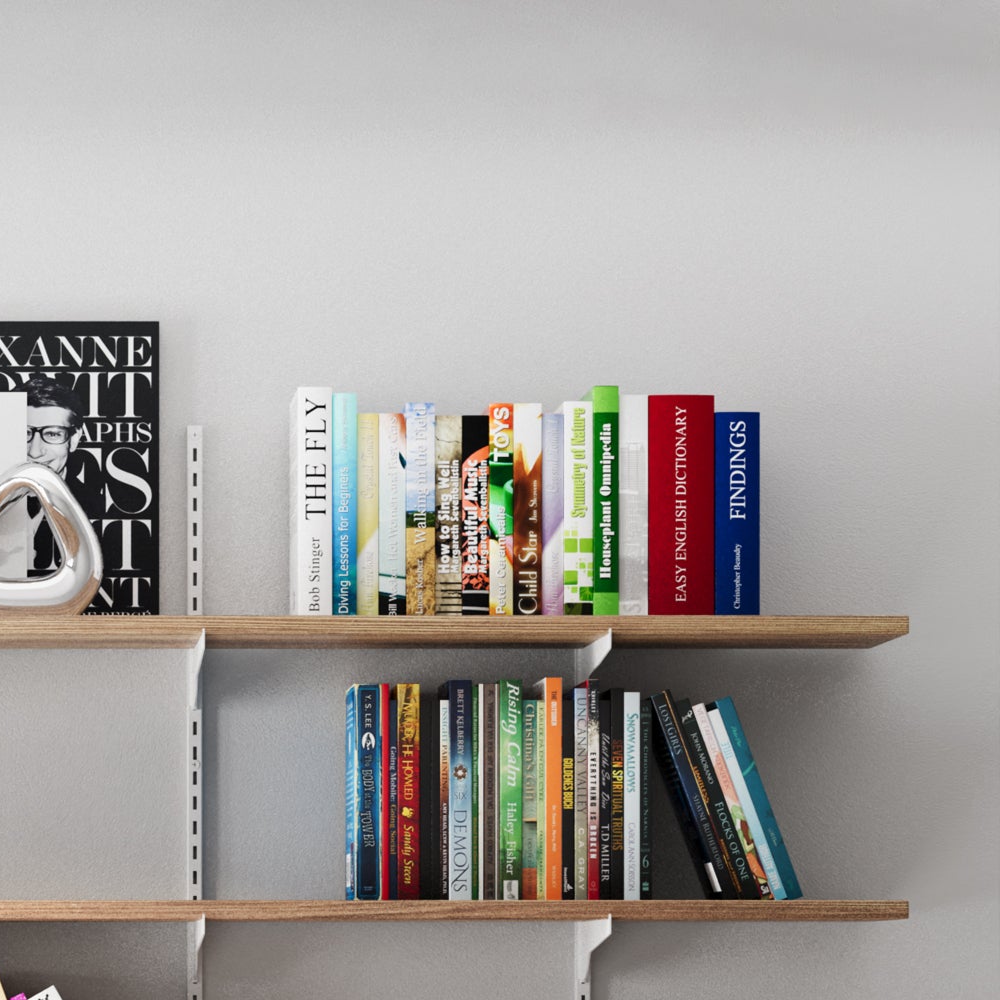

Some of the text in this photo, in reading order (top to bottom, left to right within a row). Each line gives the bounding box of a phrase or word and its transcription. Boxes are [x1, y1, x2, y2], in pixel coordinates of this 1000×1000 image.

[305, 398, 326, 520] THE FLY
[494, 406, 509, 462] TOYS
[570, 407, 587, 518] Symmetry of Nature
[729, 420, 746, 520] FINDINGS
[338, 466, 351, 614] Diving Lessons for Beginers
[438, 460, 452, 574] How to Sing Well
[464, 459, 478, 574] Beautiful Music
[600, 423, 614, 579] Houseplant Omnipedia
[675, 406, 687, 602] EASY ENGLISH DICTIONARY
[308, 537, 323, 612] Bob Stinger
[519, 530, 537, 614] Child Star
[733, 543, 742, 609] Christopher Beaudry
[364, 713, 372, 728] LEE
[502, 681, 520, 787] Rising Calm
[577, 697, 586, 814] UNCANNY VALLEY
[361, 769, 375, 791] BODY
[562, 758, 573, 809] GOLDENES BUCH
[590, 811, 597, 820] IS
[612, 739, 623, 851] SEVEN SPIRITUAL TRUTHS
[361, 810, 375, 848] TOWER
[400, 824, 413, 884] Sandy Steen
[451, 810, 468, 892] DEMONS
[503, 802, 517, 875] Haley Fisher
[601, 844, 609, 882] MILLER
